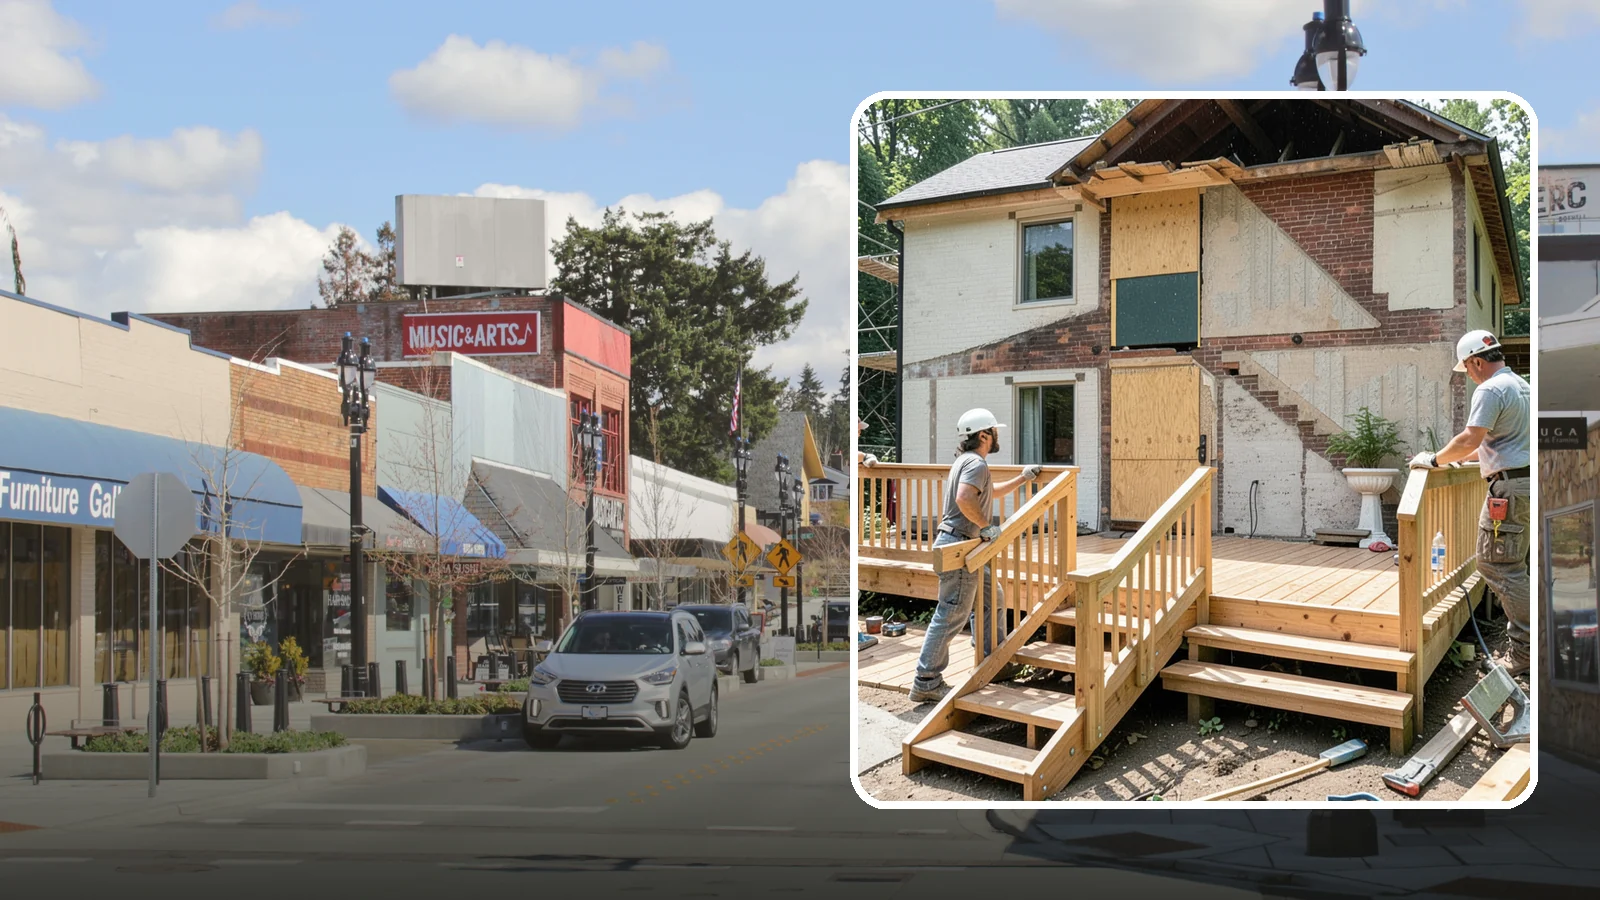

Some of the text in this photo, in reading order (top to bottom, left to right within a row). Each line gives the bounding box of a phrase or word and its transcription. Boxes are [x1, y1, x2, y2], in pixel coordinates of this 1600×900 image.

[409, 322, 520, 349] MUSIC&ARTS
[1540, 428, 1577, 437] UGA
[0, 470, 122, 519] Furniture Gal
[453, 563, 479, 574] SUSHI
